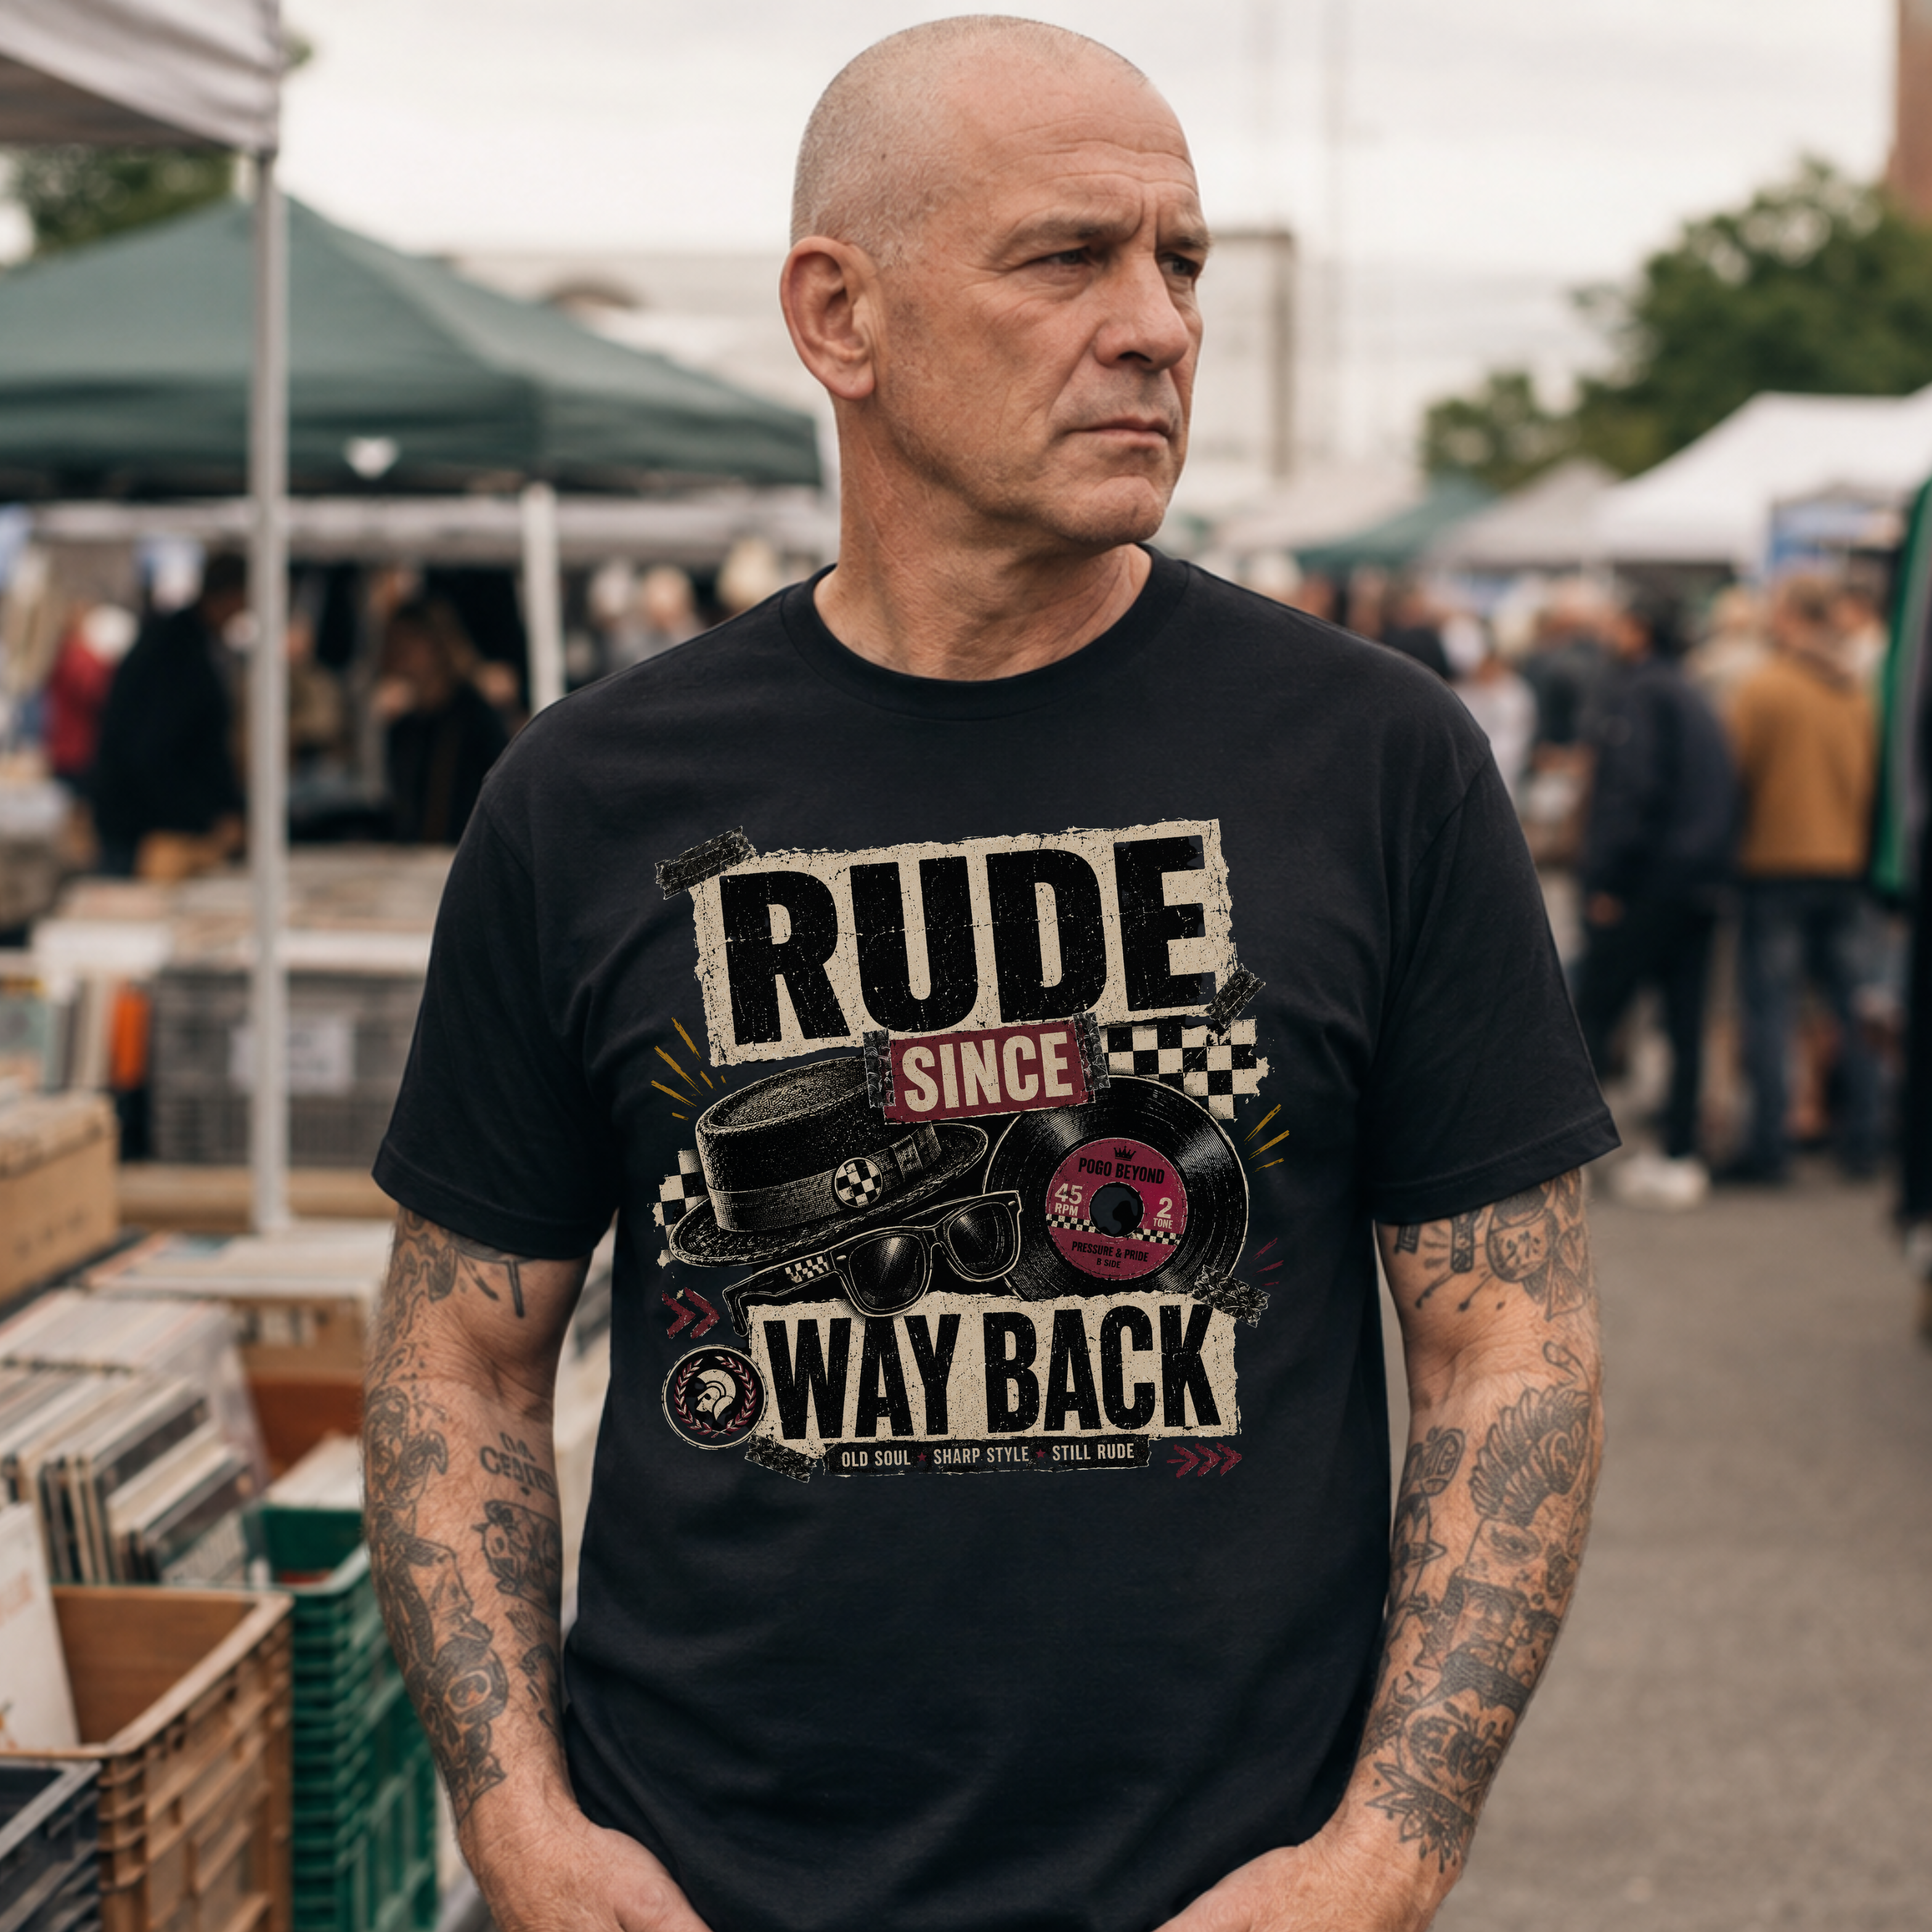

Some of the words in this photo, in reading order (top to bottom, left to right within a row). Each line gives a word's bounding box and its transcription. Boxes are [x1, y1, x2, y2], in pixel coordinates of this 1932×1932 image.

[719, 835, 1204, 1045] RUDE
[902, 1032, 1074, 1113] SINCE
[1078, 1157, 1112, 1177] POGO
[1115, 1162, 1165, 1184] BEYOND
[1054, 1183, 1083, 1204] 45
[1054, 1202, 1078, 1217] RPM
[1156, 1197, 1173, 1219] 2
[1153, 1218, 1173, 1229] TONE
[1072, 1241, 1114, 1257] PRESSURE
[1115, 1248, 1122, 1258] &
[1124, 1249, 1149, 1262] PRIDE
[1096, 1258, 1102, 1266] B
[1104, 1259, 1122, 1269] SIDE
[763, 1311, 961, 1441] WAY
[984, 1304, 1221, 1435] BACK
[841, 1450, 869, 1467] OLD
[874, 1449, 911, 1467] SOUL
[933, 1448, 980, 1465] SHARP
[986, 1446, 1030, 1464] STYLE
[1052, 1444, 1091, 1461] STILL
[1098, 1443, 1135, 1459] RUDE
